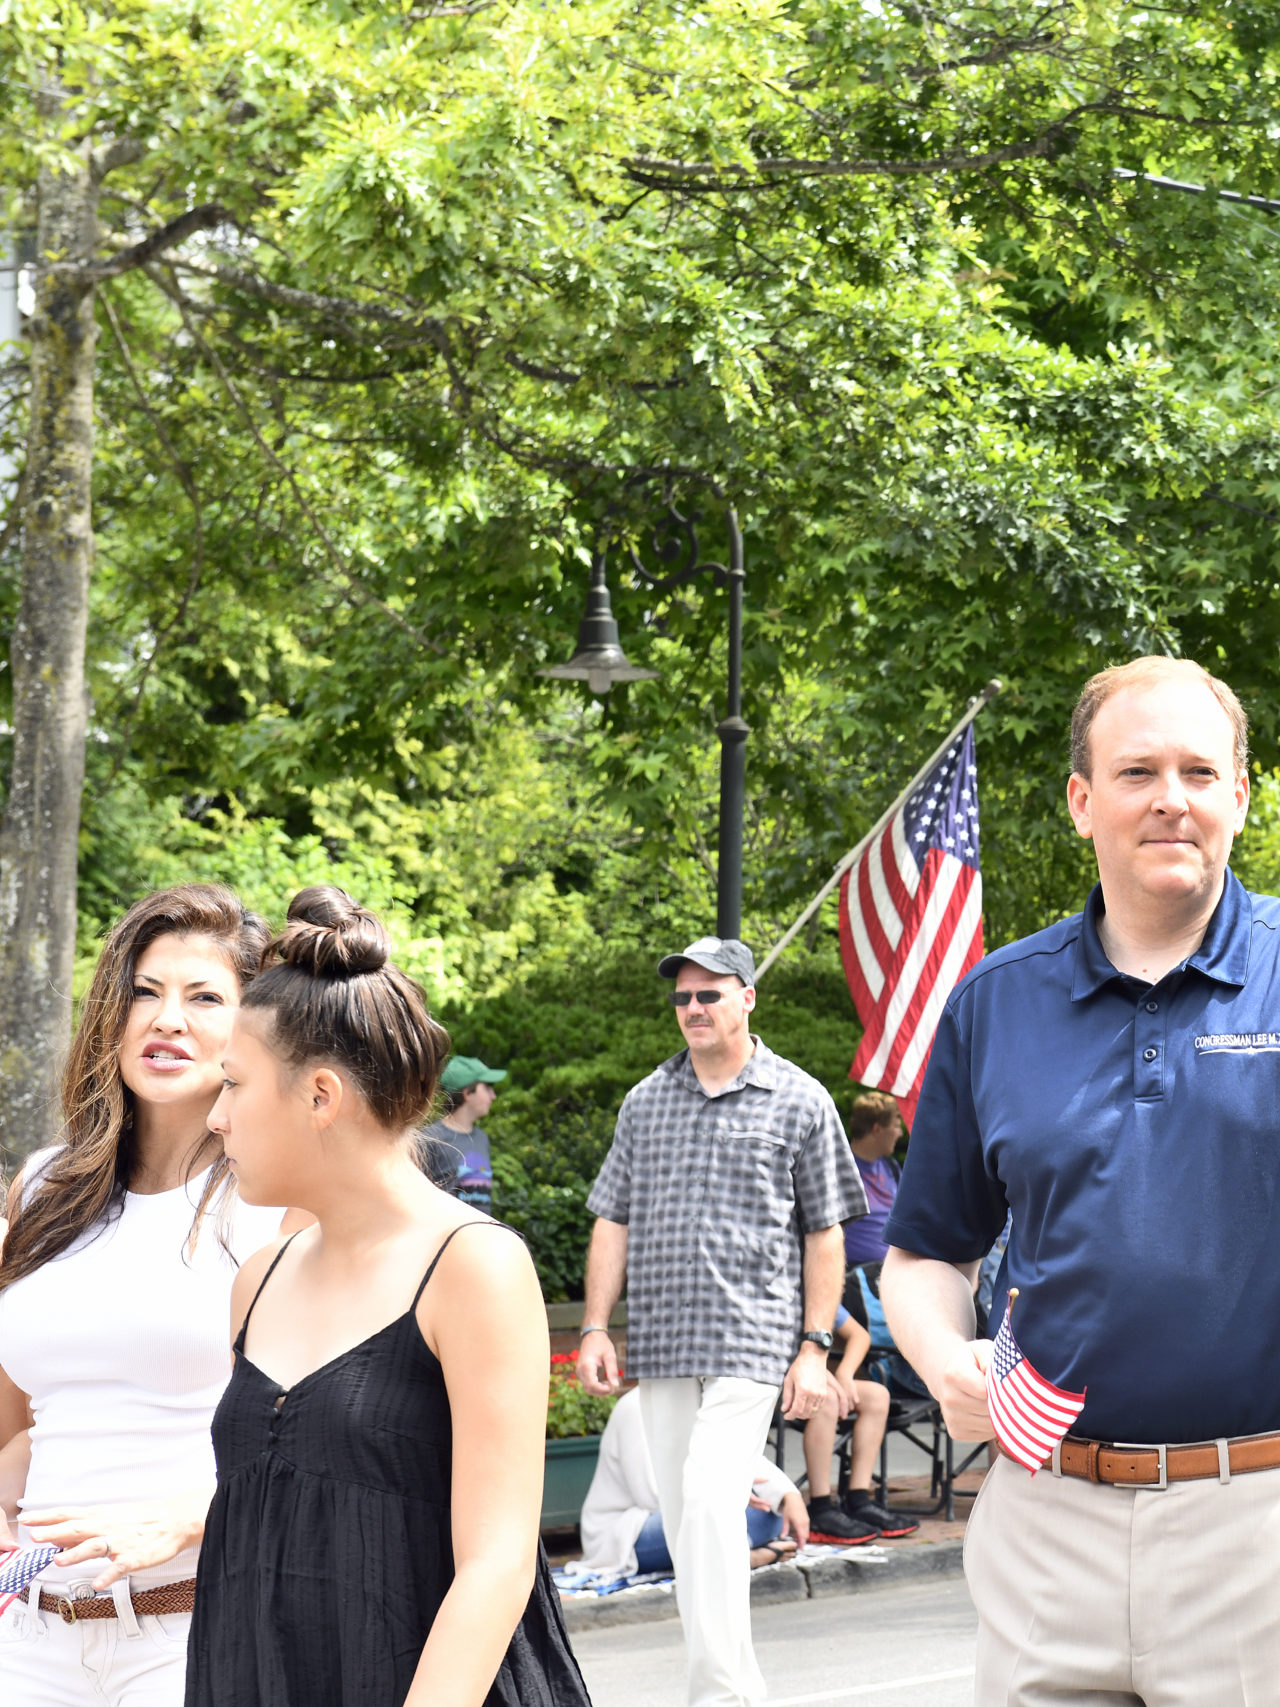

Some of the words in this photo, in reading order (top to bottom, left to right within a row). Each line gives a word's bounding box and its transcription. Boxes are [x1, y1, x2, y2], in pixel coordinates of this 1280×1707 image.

[1195, 1034, 1252, 1048] CONGRESSMAN
[1252, 1034, 1267, 1046] LEE
[1268, 1033, 1277, 1045] M.
